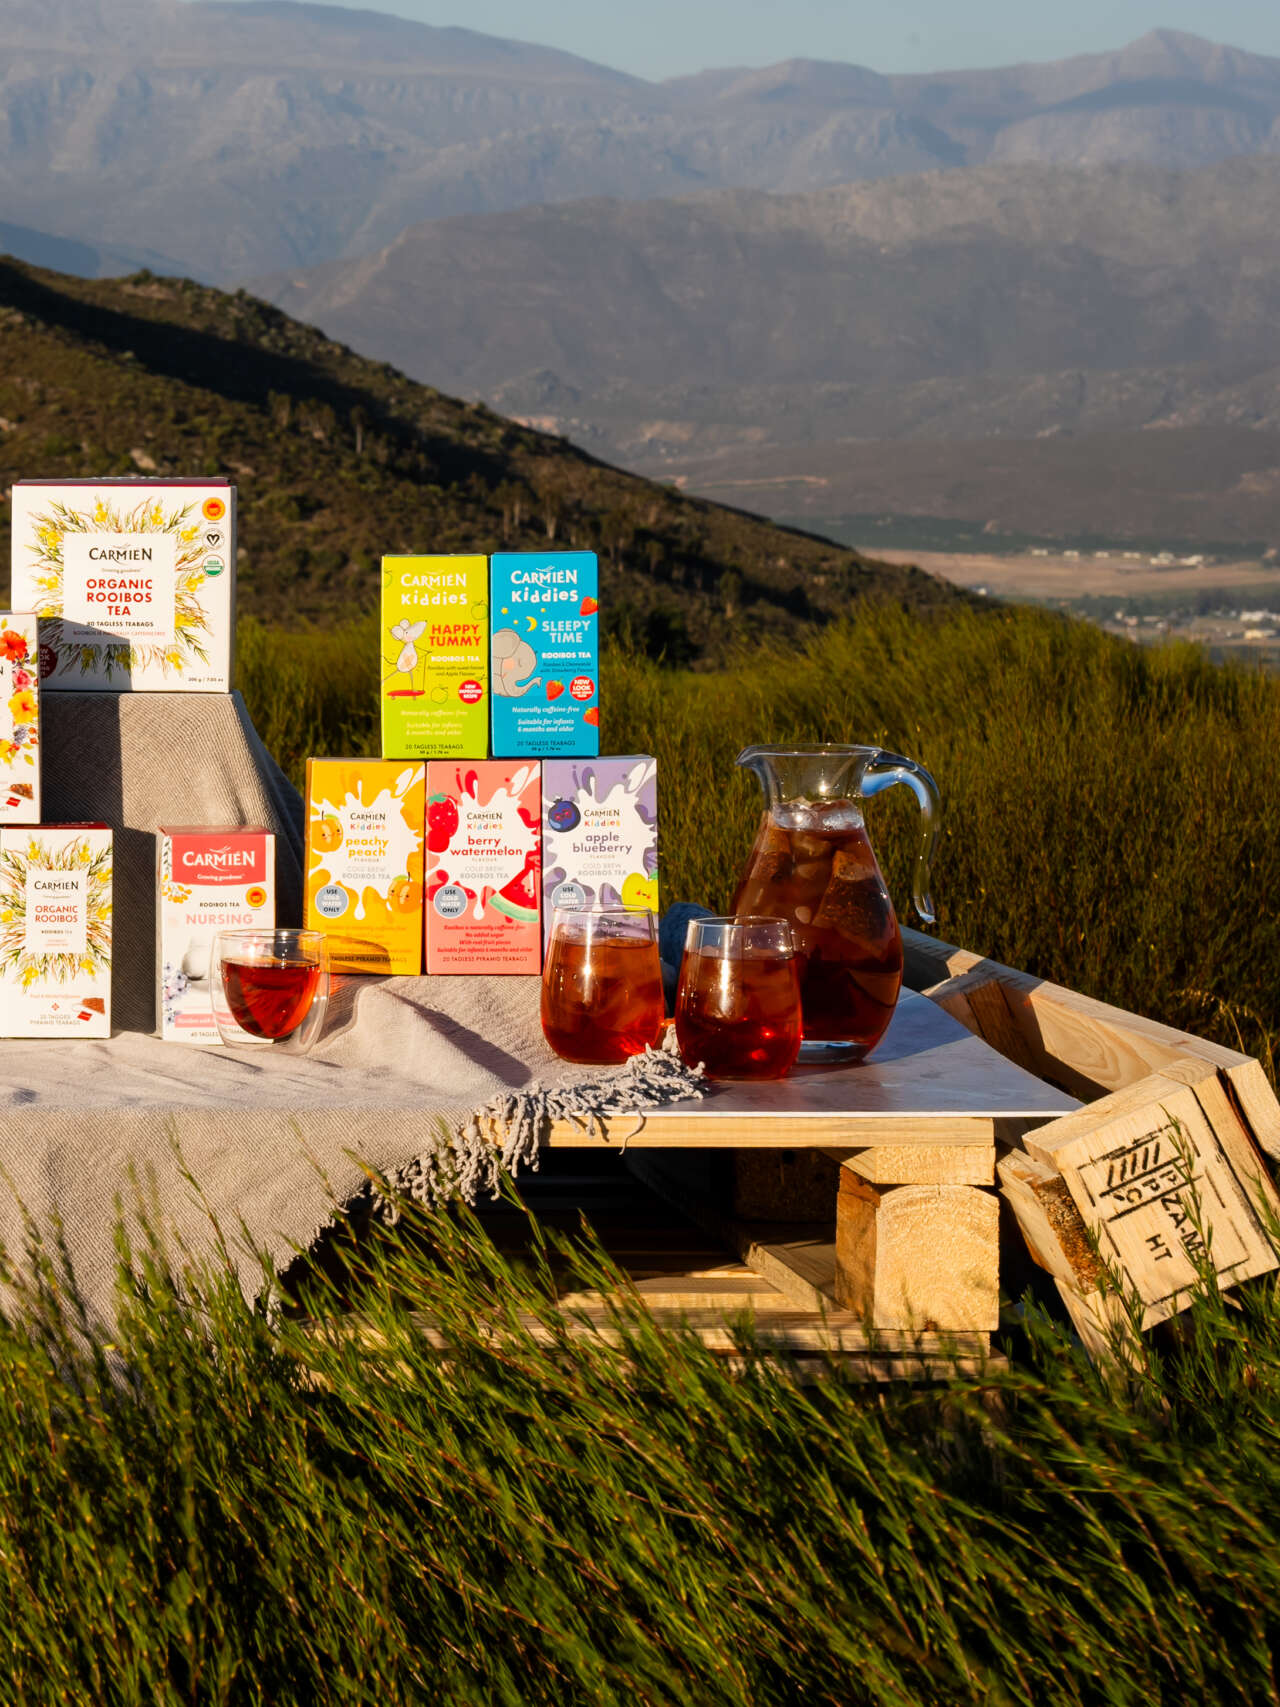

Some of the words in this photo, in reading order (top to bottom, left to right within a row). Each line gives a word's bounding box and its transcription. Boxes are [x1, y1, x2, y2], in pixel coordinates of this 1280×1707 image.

[86, 579, 153, 590] ORGANIC
[86, 592, 152, 603] ROOIBOS
[401, 591, 467, 605] Kiddies
[512, 587, 578, 603] Kiddies
[107, 606, 131, 616] TEA
[432, 624, 479, 634] HAPPY
[542, 621, 591, 631] SLEEPY
[429, 636, 481, 646] TUMMY
[550, 633, 583, 643] TIME
[467, 822, 502, 830] Kiddies
[346, 836, 389, 848] peachy
[468, 836, 501, 847] berry
[586, 832, 619, 845] apple
[349, 846, 386, 858] peach
[450, 846, 523, 856] watermelon
[573, 843, 632, 855] blueberry
[35, 905, 78, 913] ORGANIC
[35, 914, 78, 923] ROOIBOS
[186, 914, 253, 925] NURSING
[1145, 1234, 1173, 1261] HT
